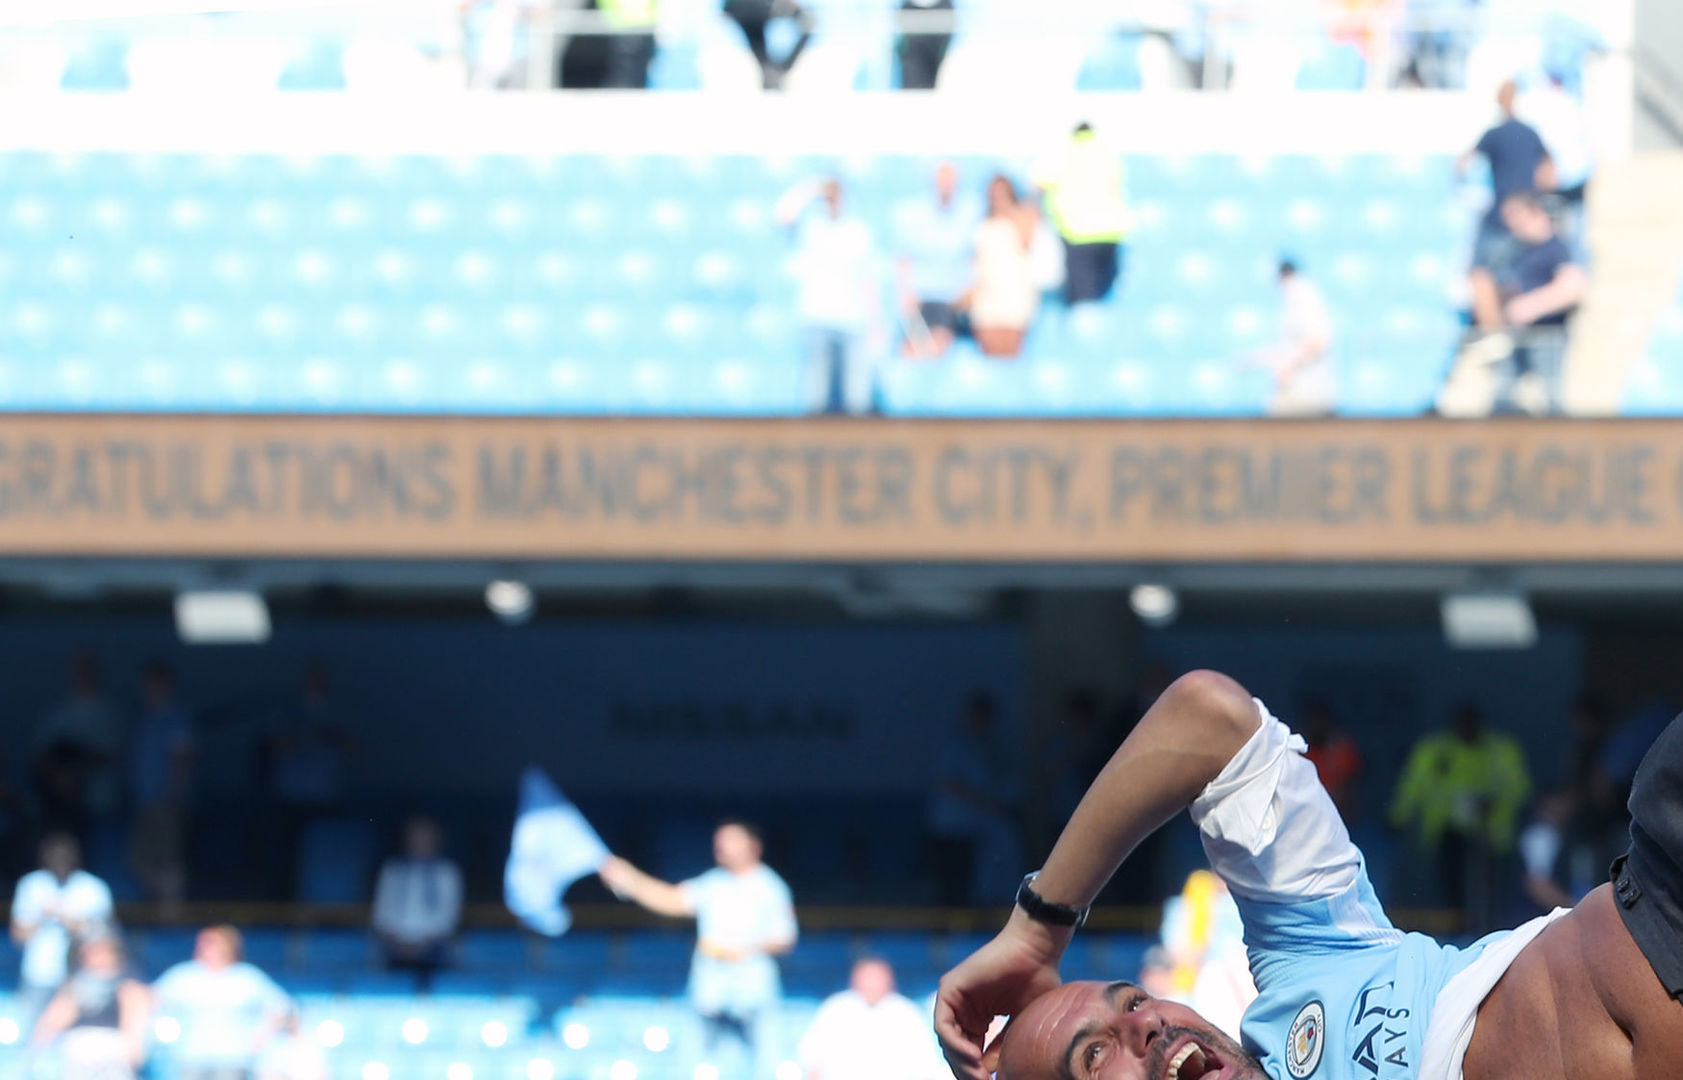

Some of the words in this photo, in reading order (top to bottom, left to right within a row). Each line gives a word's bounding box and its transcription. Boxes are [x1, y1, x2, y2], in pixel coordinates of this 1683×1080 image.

[479, 446, 913, 523] MANCHESTER
[934, 447, 1093, 530] CITY,
[1412, 446, 1659, 524] LEAGUE
